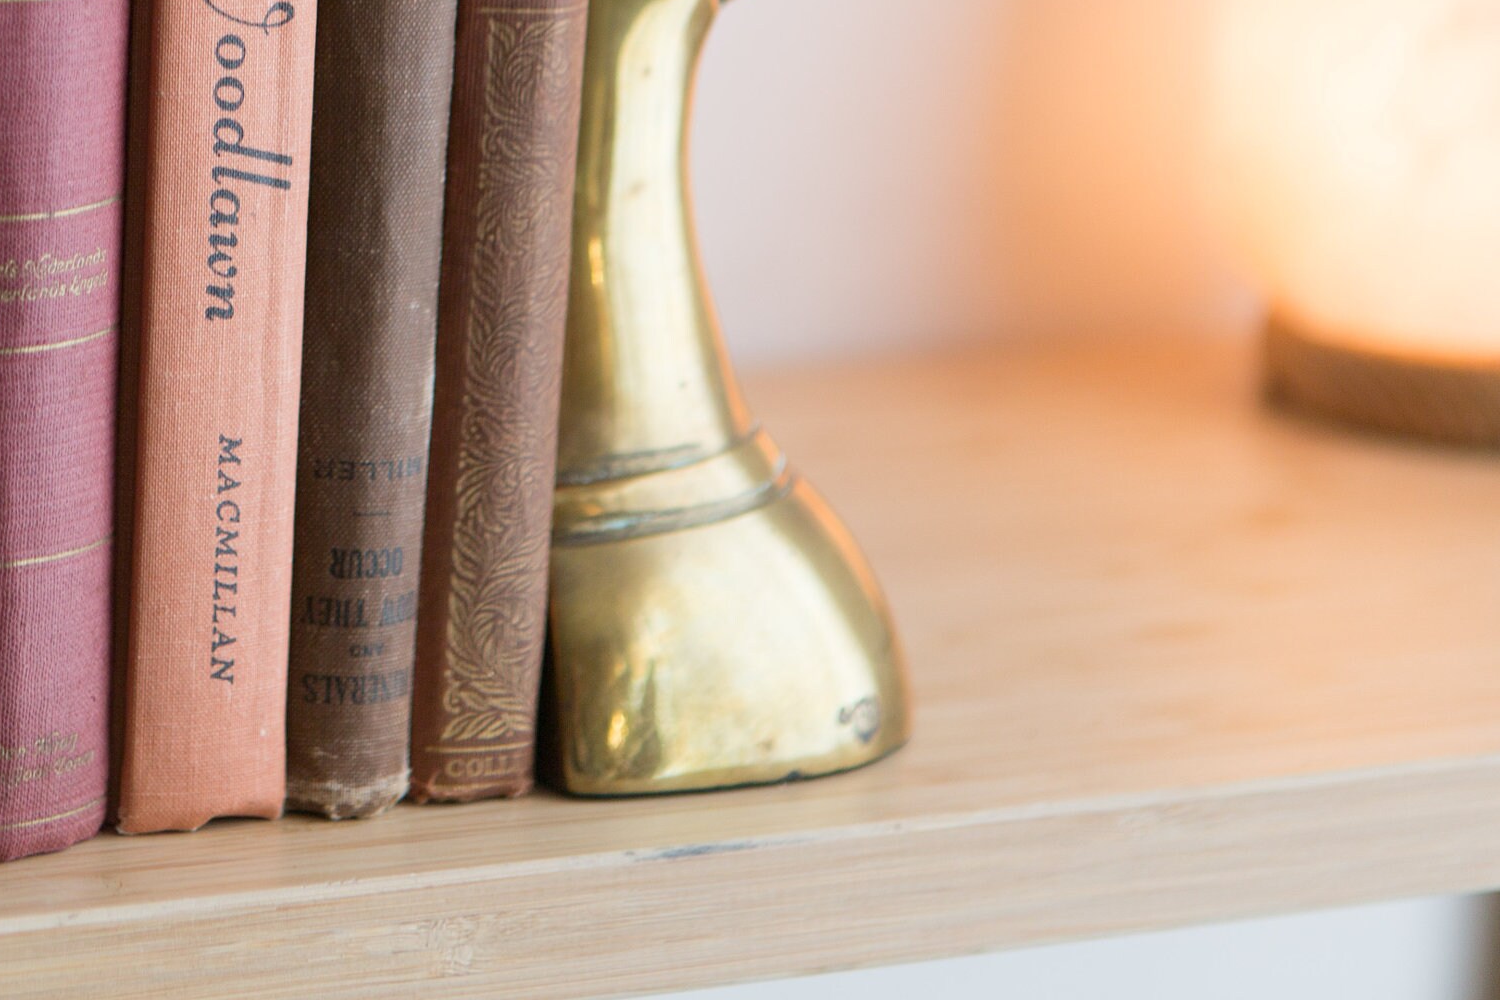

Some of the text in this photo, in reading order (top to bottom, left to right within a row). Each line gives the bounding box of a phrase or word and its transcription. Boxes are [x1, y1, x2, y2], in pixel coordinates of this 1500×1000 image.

[313, 454, 423, 481] MILLER
[210, 433, 242, 685] MACMILLAN
[329, 546, 404, 580] OCCUR
